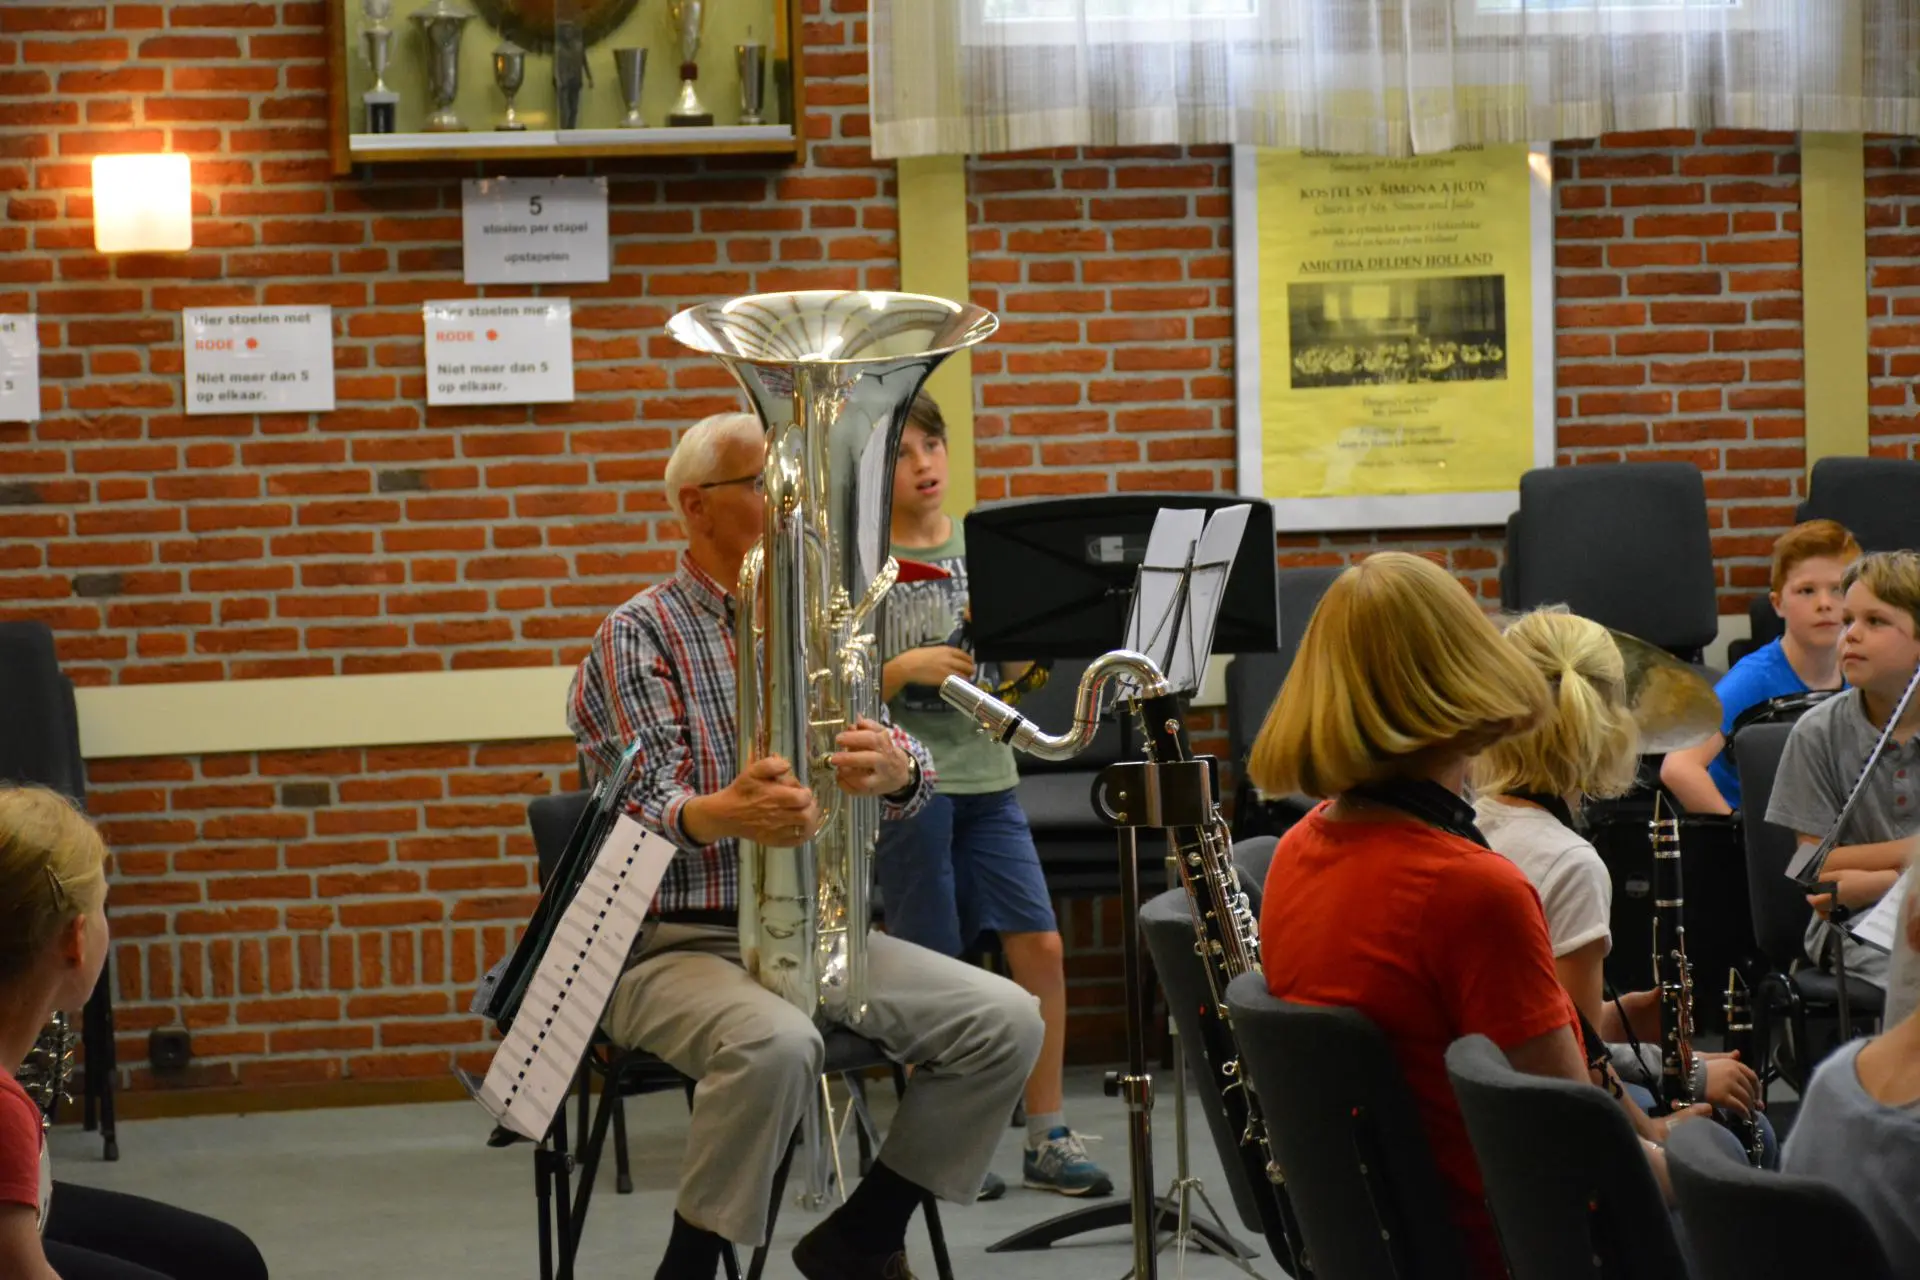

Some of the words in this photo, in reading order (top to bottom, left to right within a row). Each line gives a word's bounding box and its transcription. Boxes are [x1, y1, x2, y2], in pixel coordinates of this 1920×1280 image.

[1300, 186, 1351, 201] KOSTEL
[529, 195, 542, 216] 5
[530, 223, 549, 235] per
[1300, 257, 1364, 273] AMICITIA
[1368, 255, 1423, 271] DELDEN
[1426, 252, 1494, 269] HOLLAND
[468, 304, 519, 317] stoelen
[228, 312, 279, 325] stoelen
[284, 312, 311, 323] met
[437, 363, 466, 375] Niet
[470, 364, 505, 375] meer
[510, 362, 536, 373] dan
[540, 361, 549, 373] 5
[196, 372, 225, 384] Niet
[229, 372, 266, 383] meer
[270, 370, 296, 382] dan
[301, 370, 309, 382] 5
[438, 381, 455, 394] op
[459, 380, 508, 393] elkaar.
[196, 391, 214, 403] op
[218, 389, 267, 401] elkaar.
